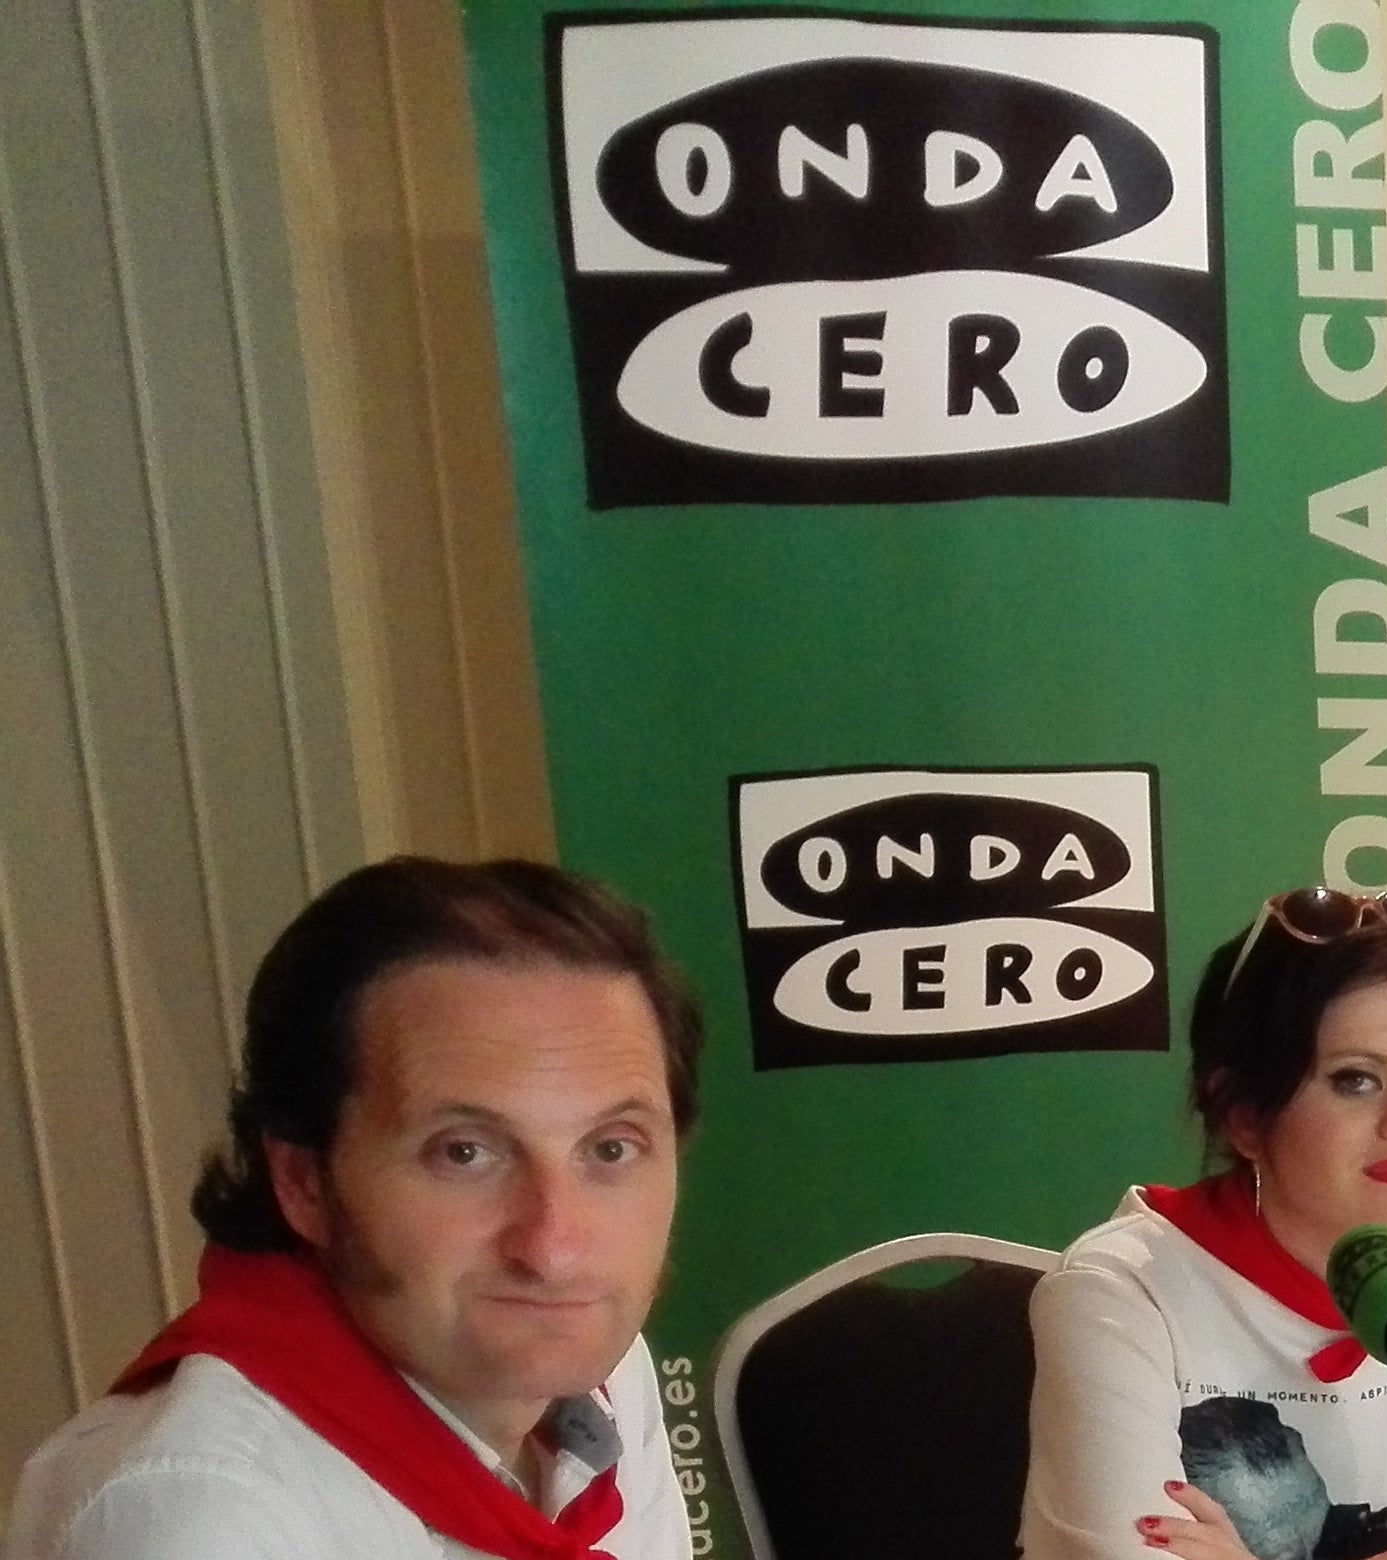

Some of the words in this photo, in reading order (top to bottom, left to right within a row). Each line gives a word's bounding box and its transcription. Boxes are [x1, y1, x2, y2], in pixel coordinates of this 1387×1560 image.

[654, 121, 1118, 218] ONDA
[698, 311, 1131, 420] CERO
[798, 833, 1096, 892] ONDA
[825, 943, 1105, 1012] CERO
